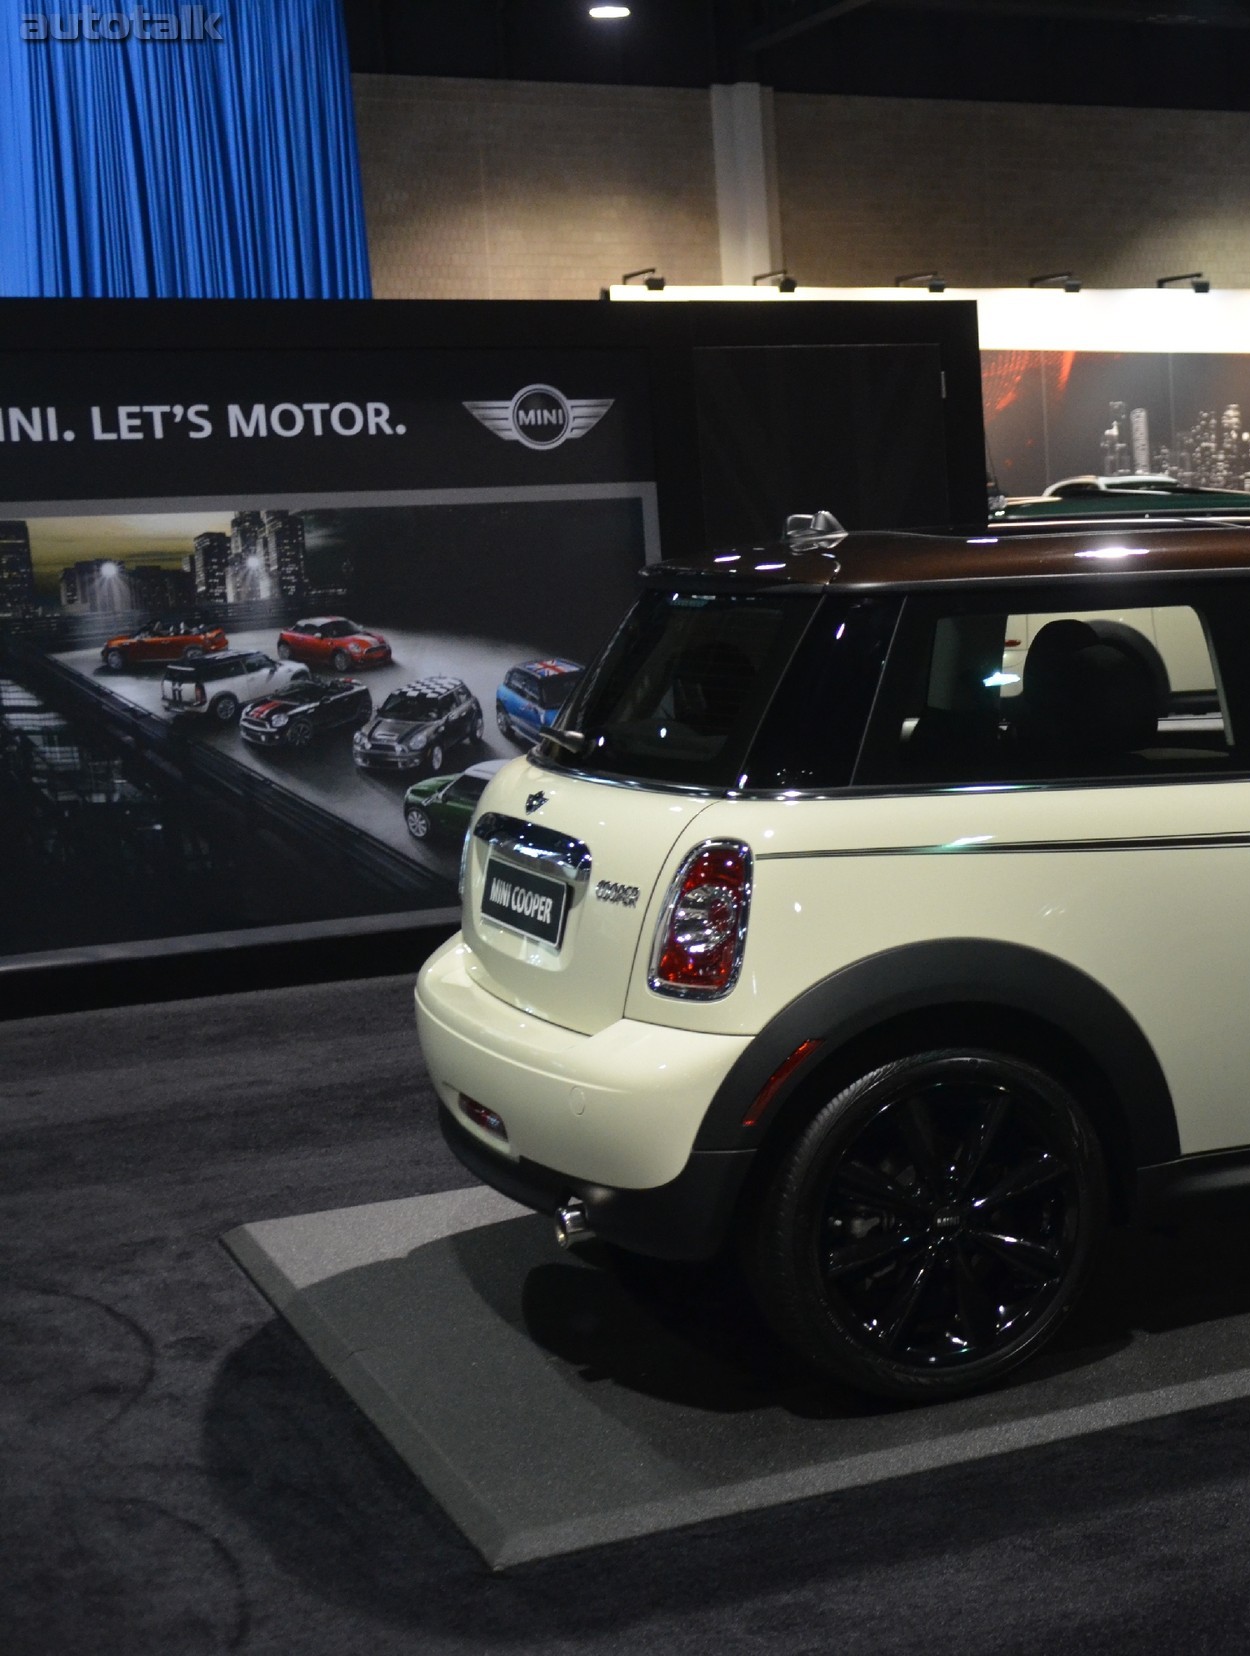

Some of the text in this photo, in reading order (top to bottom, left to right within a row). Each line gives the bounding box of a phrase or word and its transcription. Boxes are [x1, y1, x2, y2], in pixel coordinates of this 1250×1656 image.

[91, 404, 213, 440] LET’S
[227, 402, 407, 438] MOTOR.
[518, 409, 564, 426] MINI
[489, 877, 553, 924] MINI COOPER
